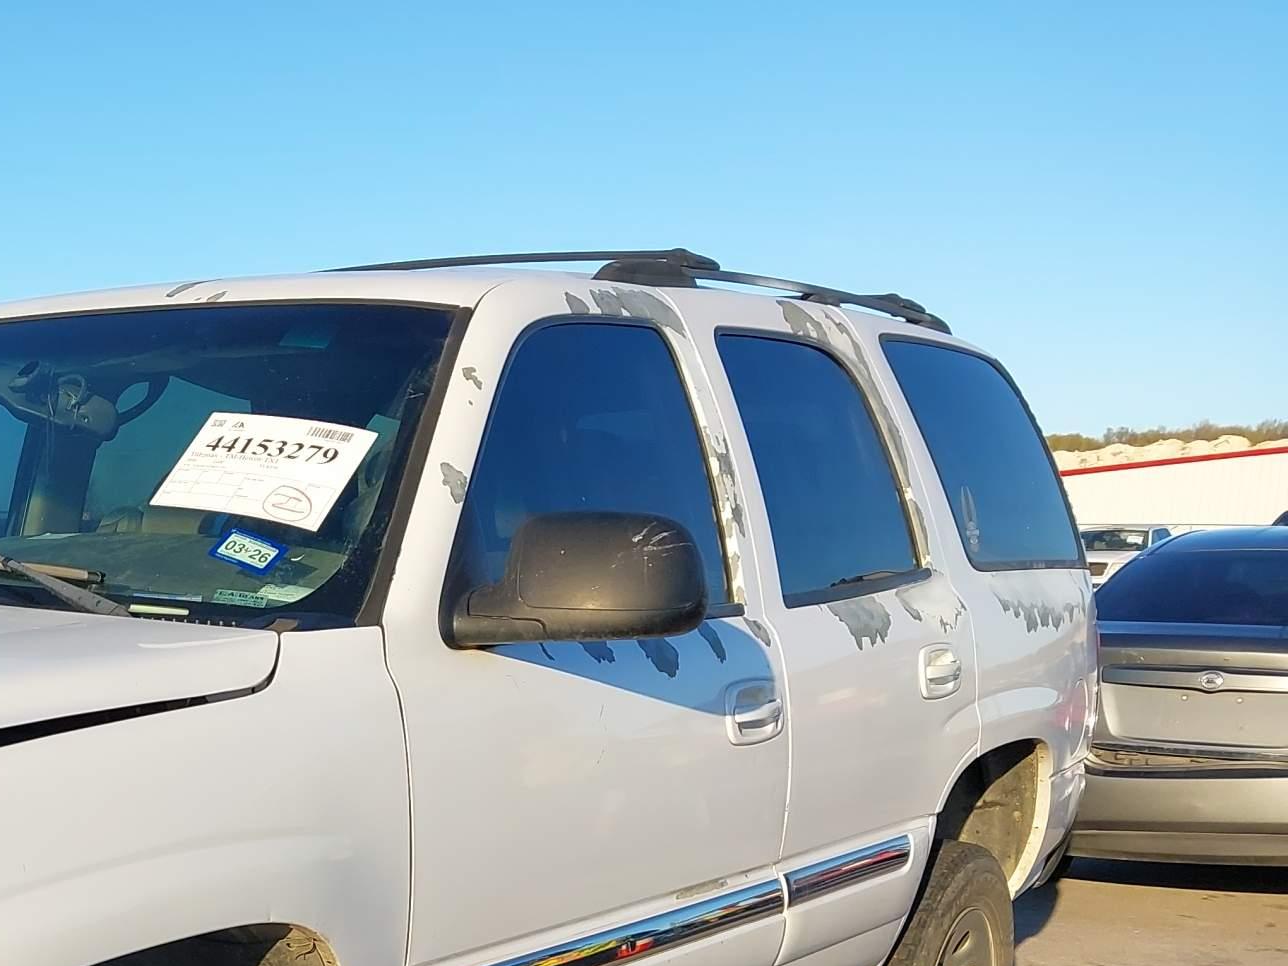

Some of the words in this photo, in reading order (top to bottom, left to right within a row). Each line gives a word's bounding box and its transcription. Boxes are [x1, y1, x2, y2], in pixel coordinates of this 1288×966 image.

[205, 435, 340, 465] 44153279
[224, 540, 246, 554] 03
[247, 548, 272, 564] 26
